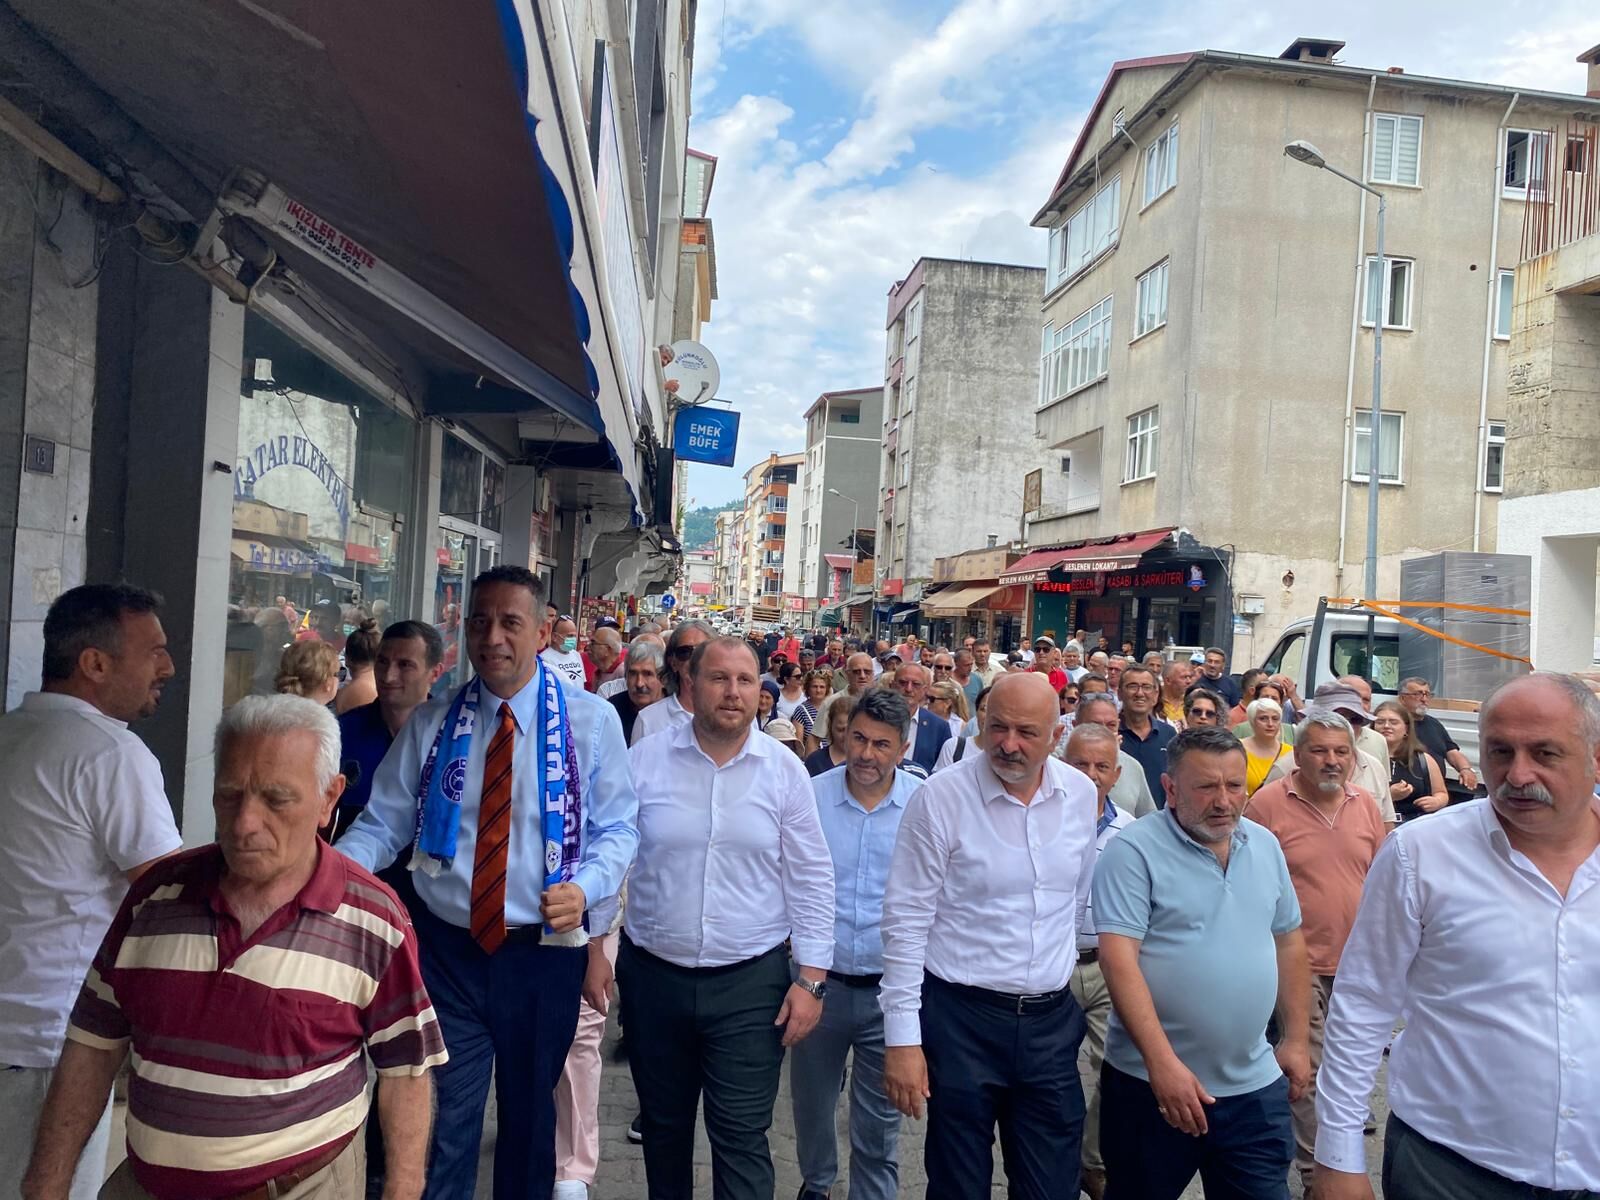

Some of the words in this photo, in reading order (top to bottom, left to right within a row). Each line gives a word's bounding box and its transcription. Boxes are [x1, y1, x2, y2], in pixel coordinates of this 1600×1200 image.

[339, 235, 377, 269] TENTE
[690, 423, 722, 438] EMEK
[688, 435, 719, 450] BÜFE
[1092, 561, 1118, 571] LOKANTA
[1018, 574, 1035, 582] KASAP
[1107, 575, 1132, 587] KASABI
